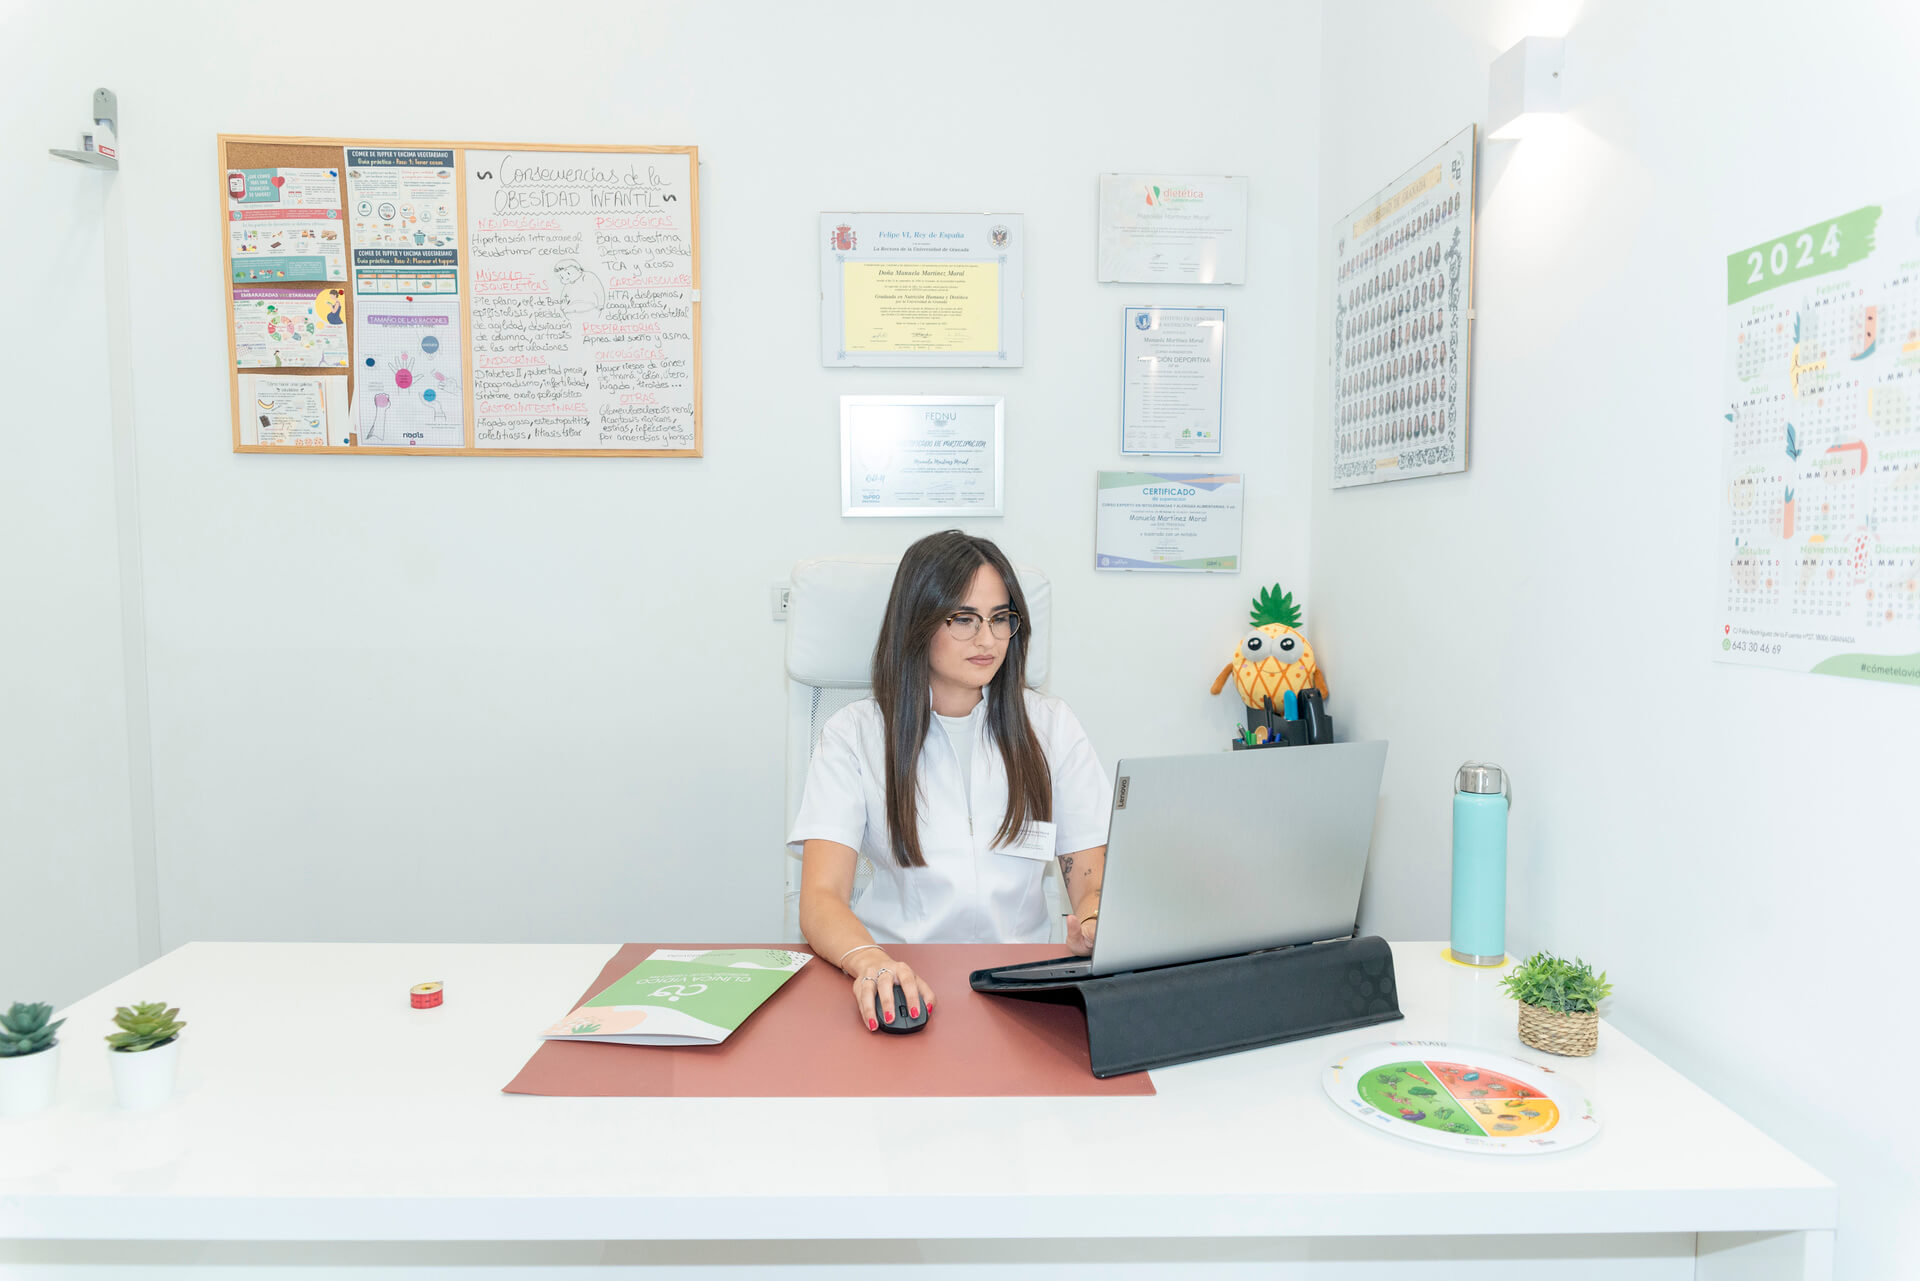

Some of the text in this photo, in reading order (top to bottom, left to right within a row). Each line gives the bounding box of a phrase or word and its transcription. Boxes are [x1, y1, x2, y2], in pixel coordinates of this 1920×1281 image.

[495, 189, 660, 212] OBESIDAD INFANTIL
[1747, 223, 1843, 285] 2024
[602, 261, 674, 277] TCA y acoso
[1143, 488, 1196, 496] CERTIFICADO
[1732, 641, 1781, 654] 643 30 46 69
[1117, 779, 1127, 807] Lenovo
